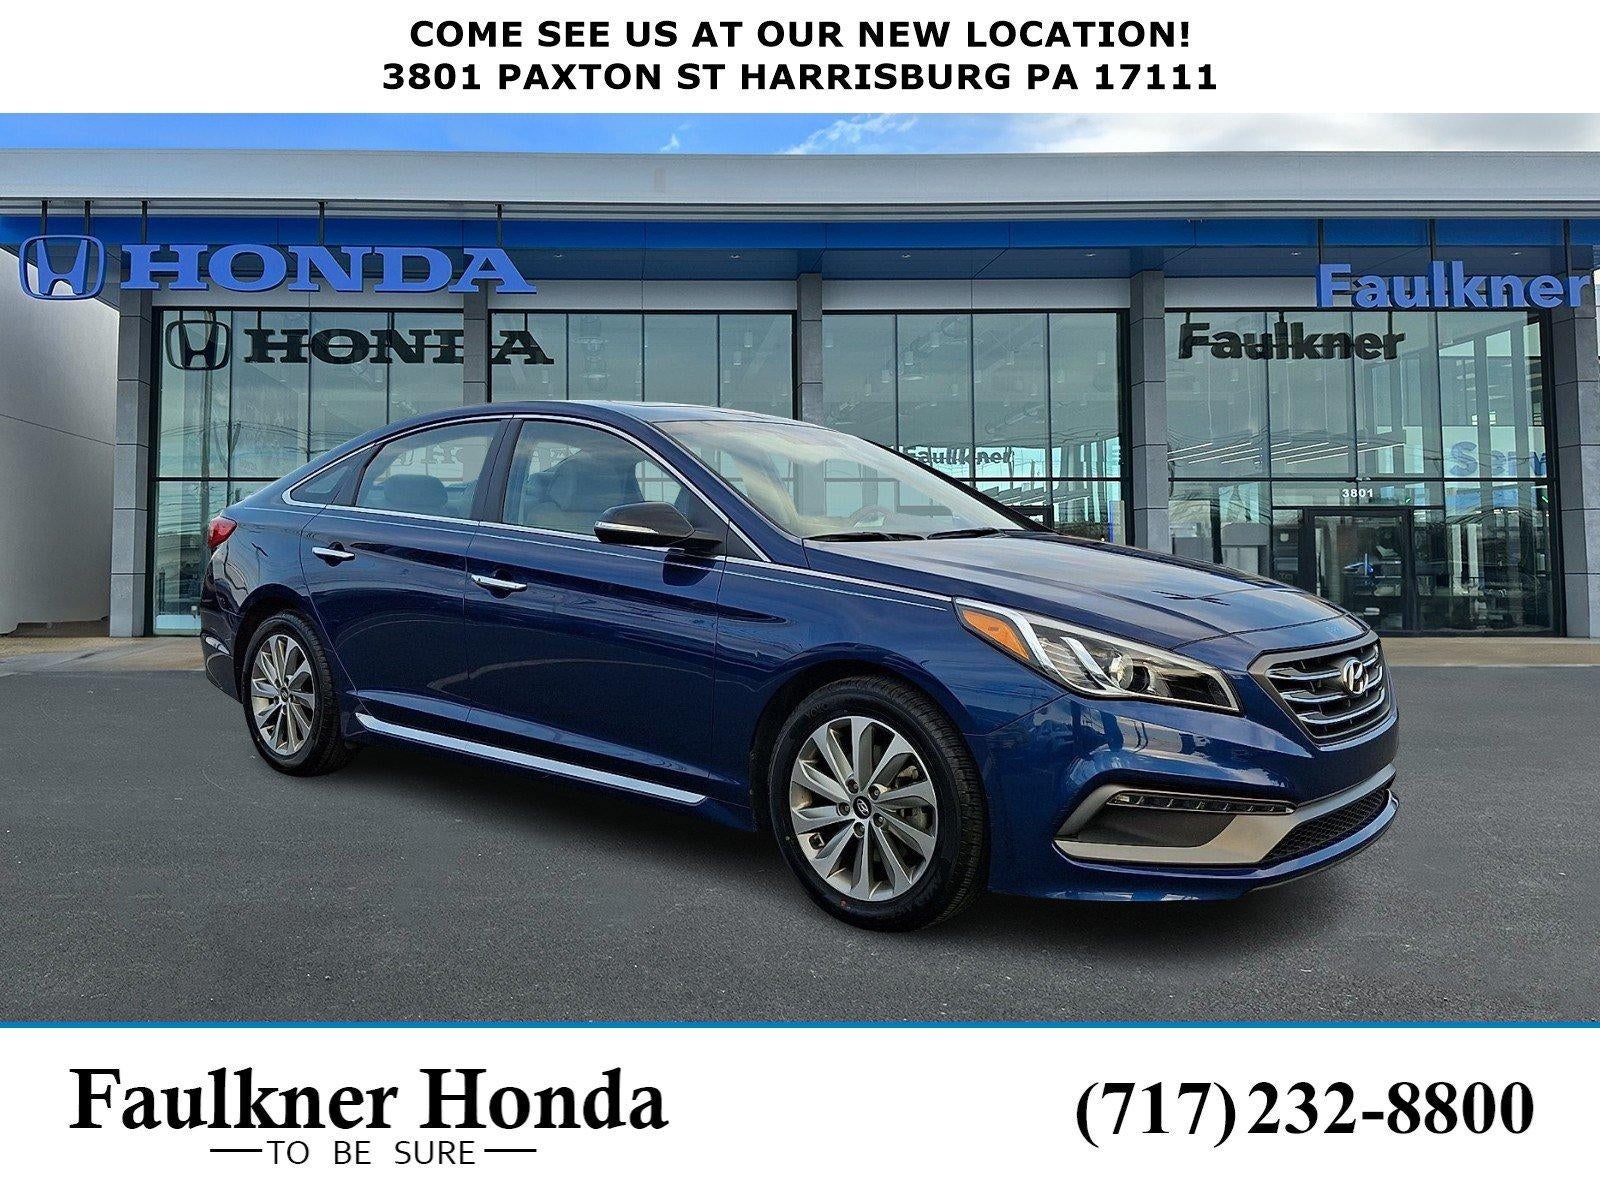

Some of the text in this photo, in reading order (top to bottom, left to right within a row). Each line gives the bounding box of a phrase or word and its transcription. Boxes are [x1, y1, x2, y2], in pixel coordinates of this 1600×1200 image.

[120, 244, 537, 295] HONDA
[1317, 261, 1591, 309] Faulkner
[1178, 321, 1404, 359] Faulkner
[1342, 488, 1374, 498] 3801
